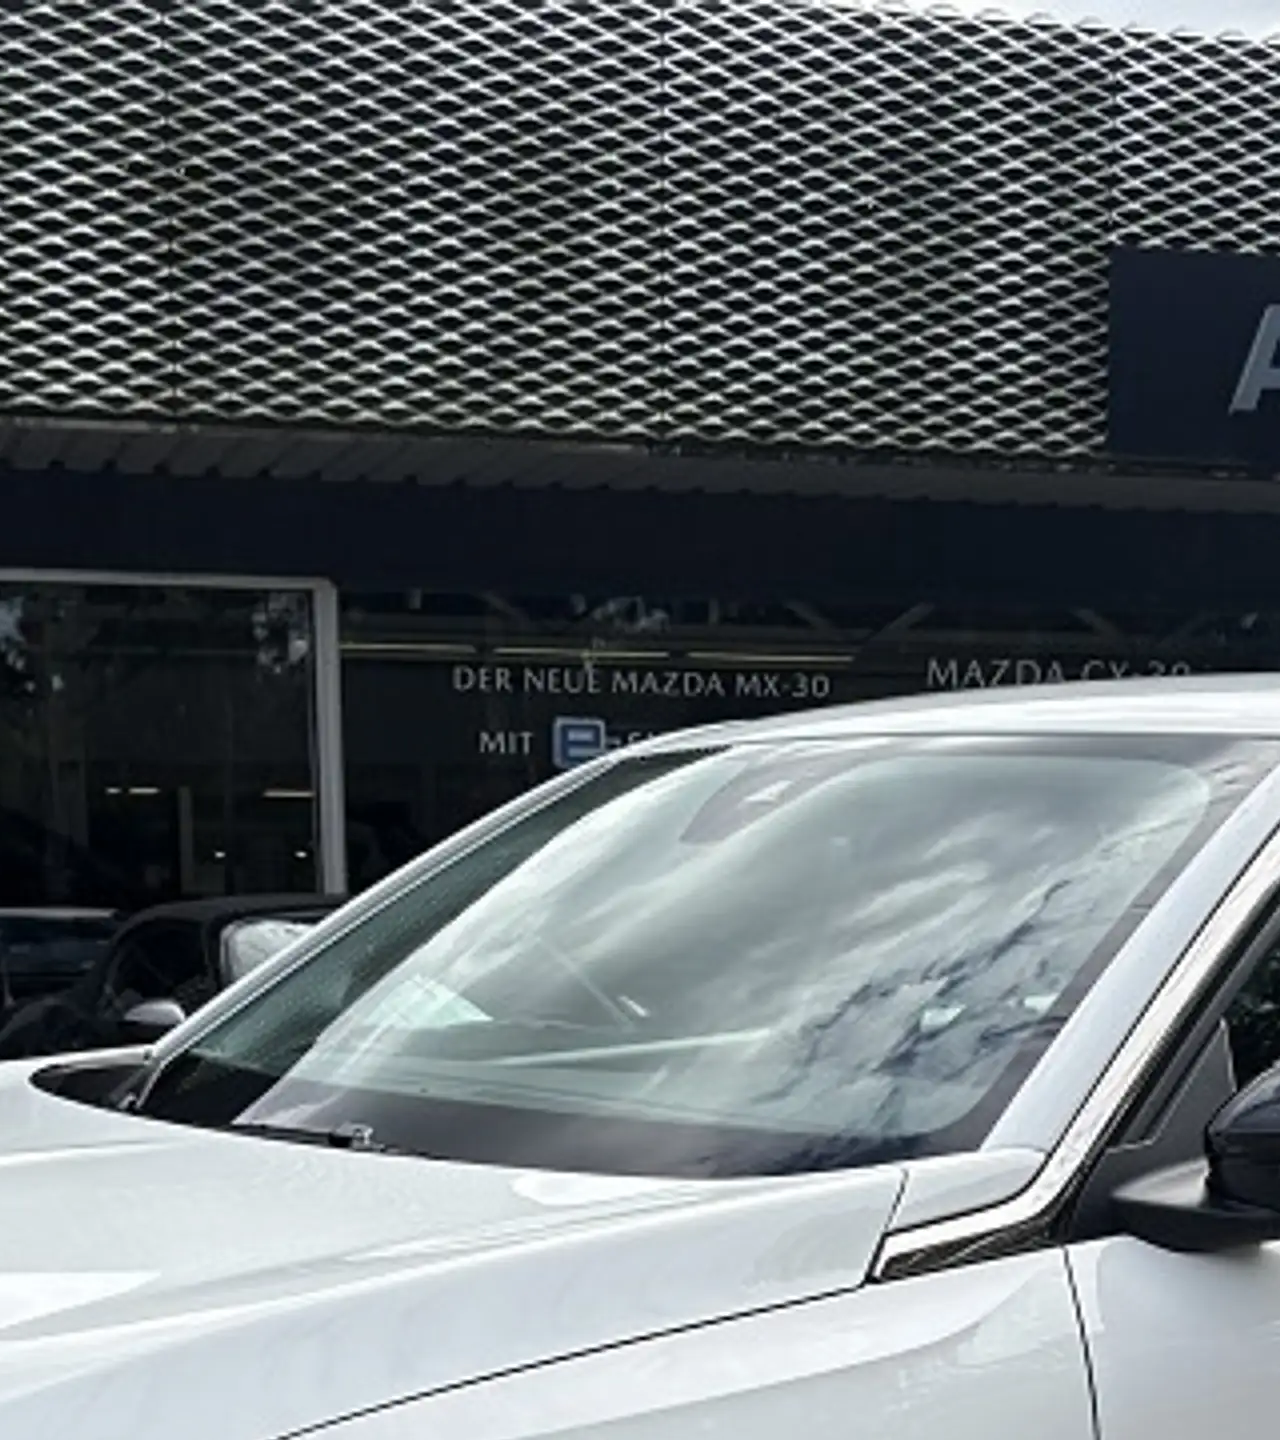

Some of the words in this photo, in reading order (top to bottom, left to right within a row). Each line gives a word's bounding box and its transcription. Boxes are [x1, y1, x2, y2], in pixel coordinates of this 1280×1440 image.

[452, 666, 513, 692] DER
[522, 667, 601, 694] NEUE
[611, 670, 725, 697] MAZDA
[735, 673, 831, 699] MX-30
[926, 656, 1067, 688] MAZDA
[478, 730, 535, 755] MIT
